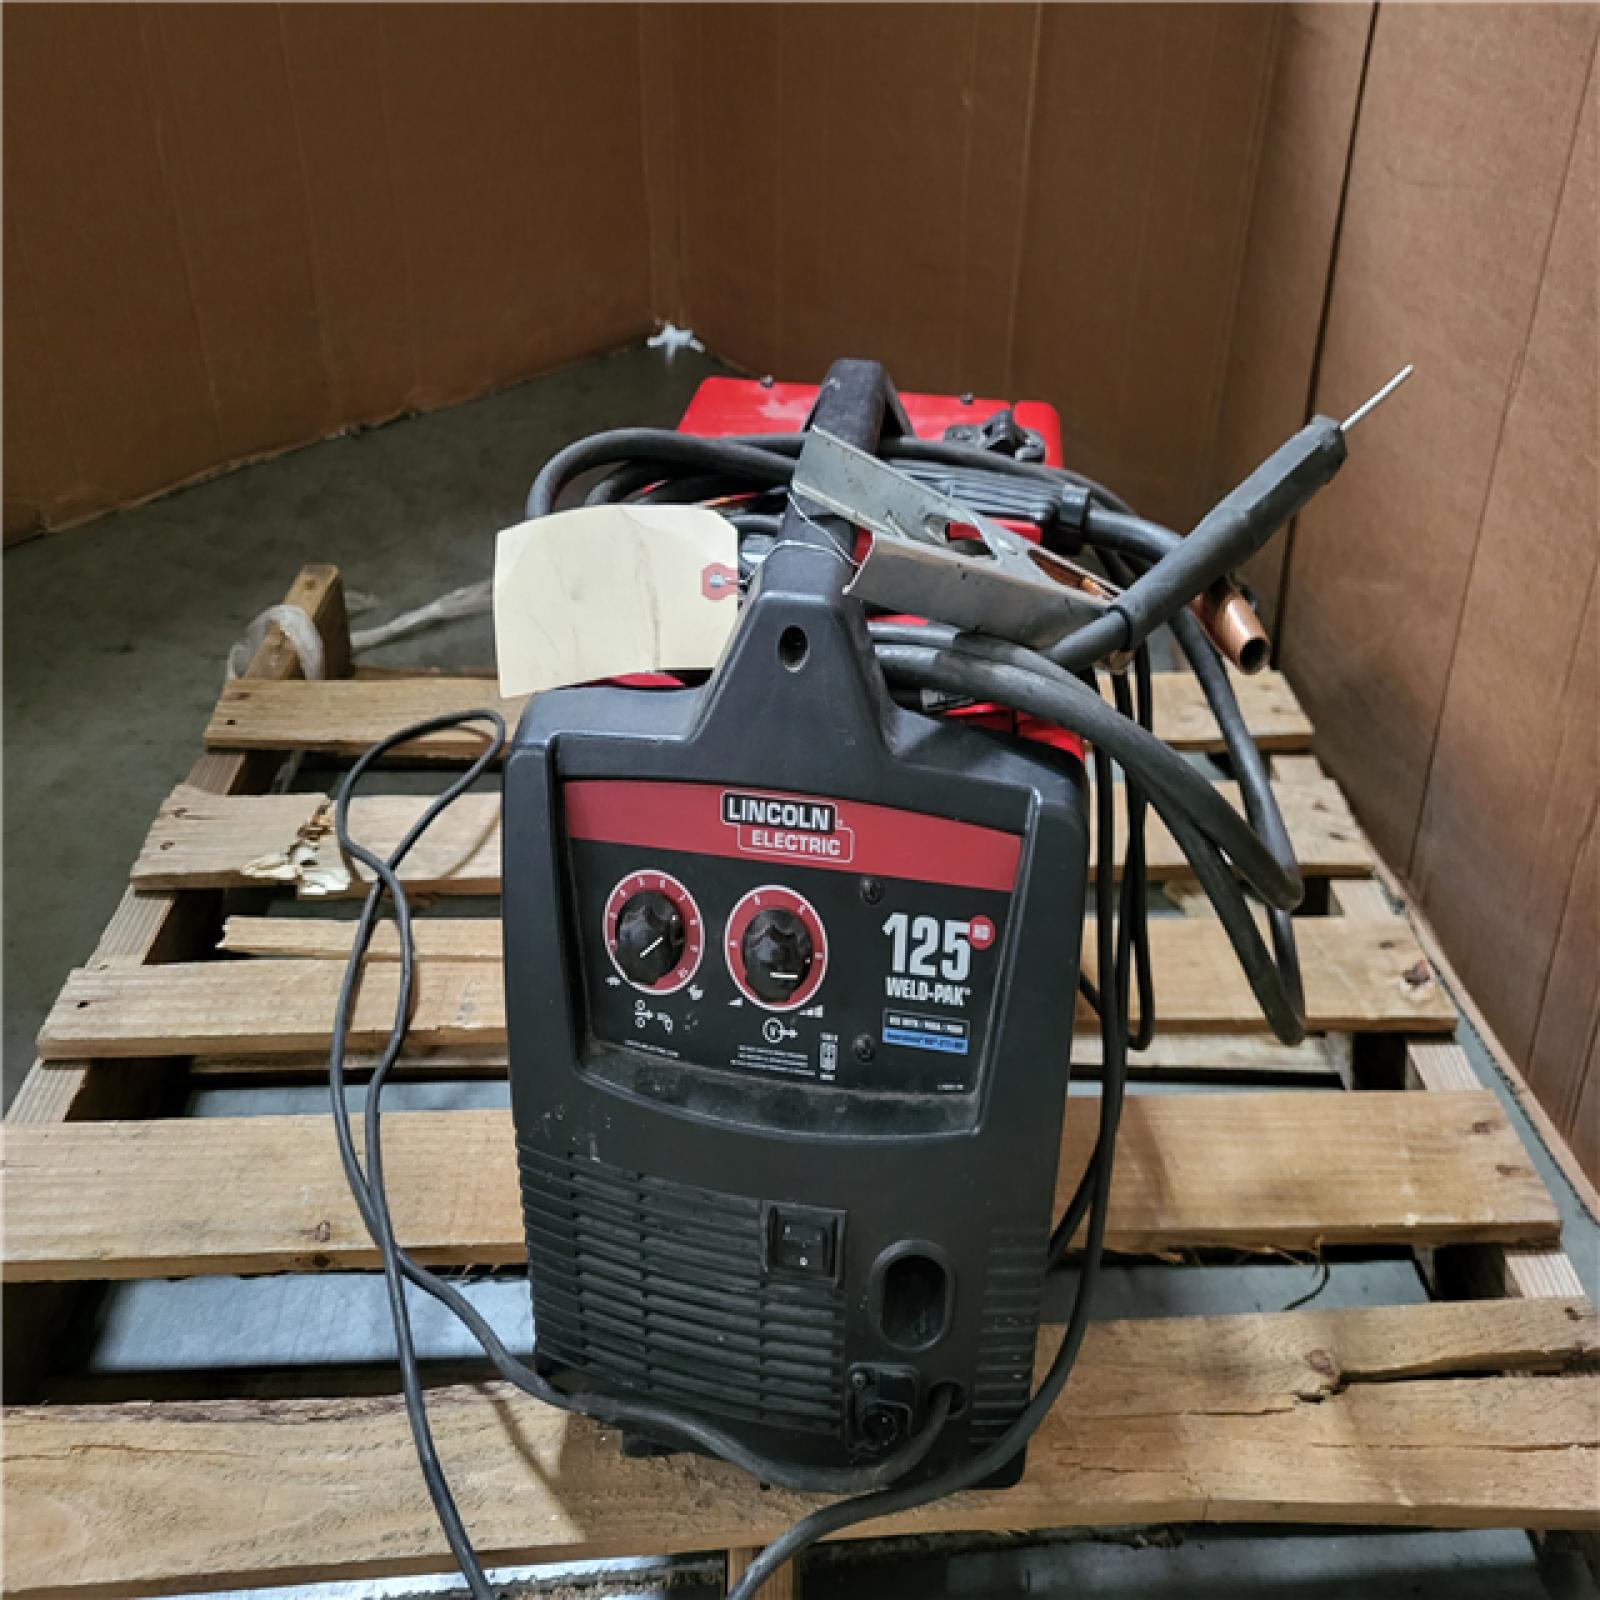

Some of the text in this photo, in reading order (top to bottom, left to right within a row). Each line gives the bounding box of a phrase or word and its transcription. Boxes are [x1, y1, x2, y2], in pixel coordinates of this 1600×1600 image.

[729, 797, 830, 831] LINCOLN
[751, 829, 841, 856] ELECTRIC
[882, 912, 971, 980] 125
